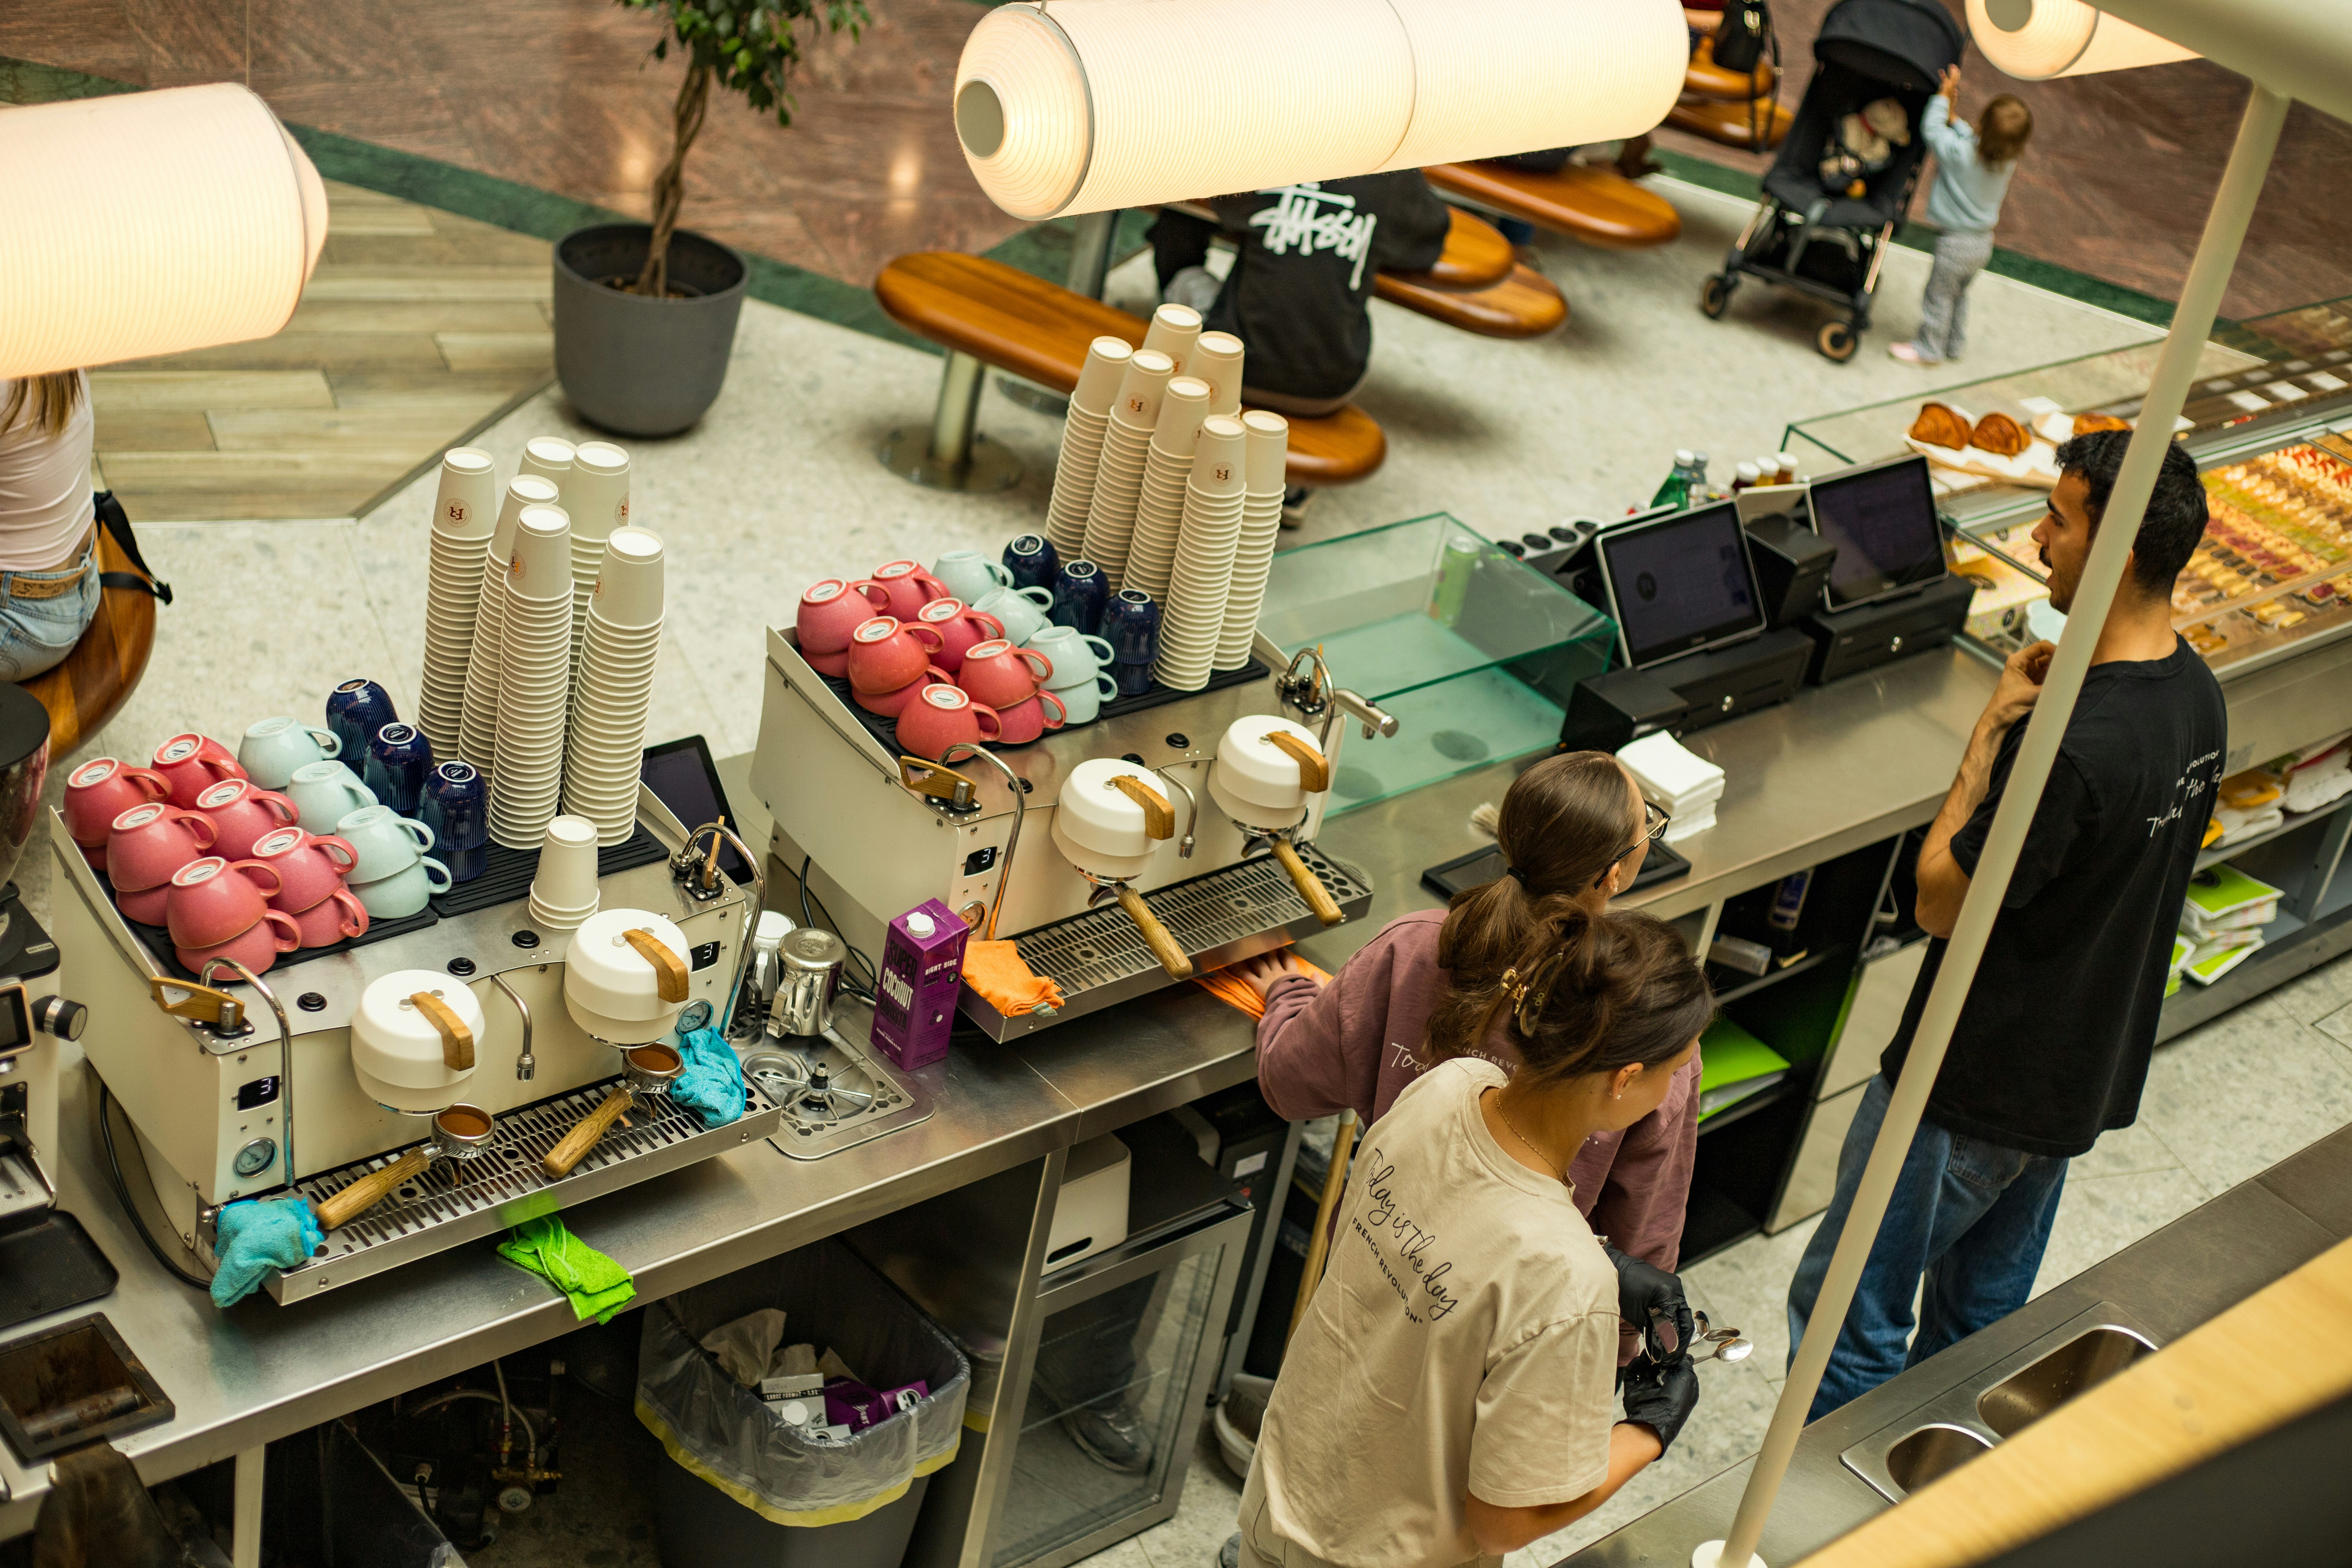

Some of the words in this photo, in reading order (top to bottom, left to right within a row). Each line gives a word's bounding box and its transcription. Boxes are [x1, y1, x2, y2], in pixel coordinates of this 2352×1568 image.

[450, 506, 464, 520] FR
[982, 848, 991, 863] 3
[887, 940, 917, 986] SUPER
[925, 963, 942, 975] RIGHT
[944, 959, 957, 968] SIDE
[883, 967, 914, 1011] COCONUT
[879, 992, 908, 1031] BARISTA
[260, 1078, 271, 1095] 3
[1352, 1217, 1380, 1259] FRENCH
[1366, 1147, 1396, 1226] Today
[1392, 1213, 1411, 1239] is
[1423, 1262, 1458, 1321] day
